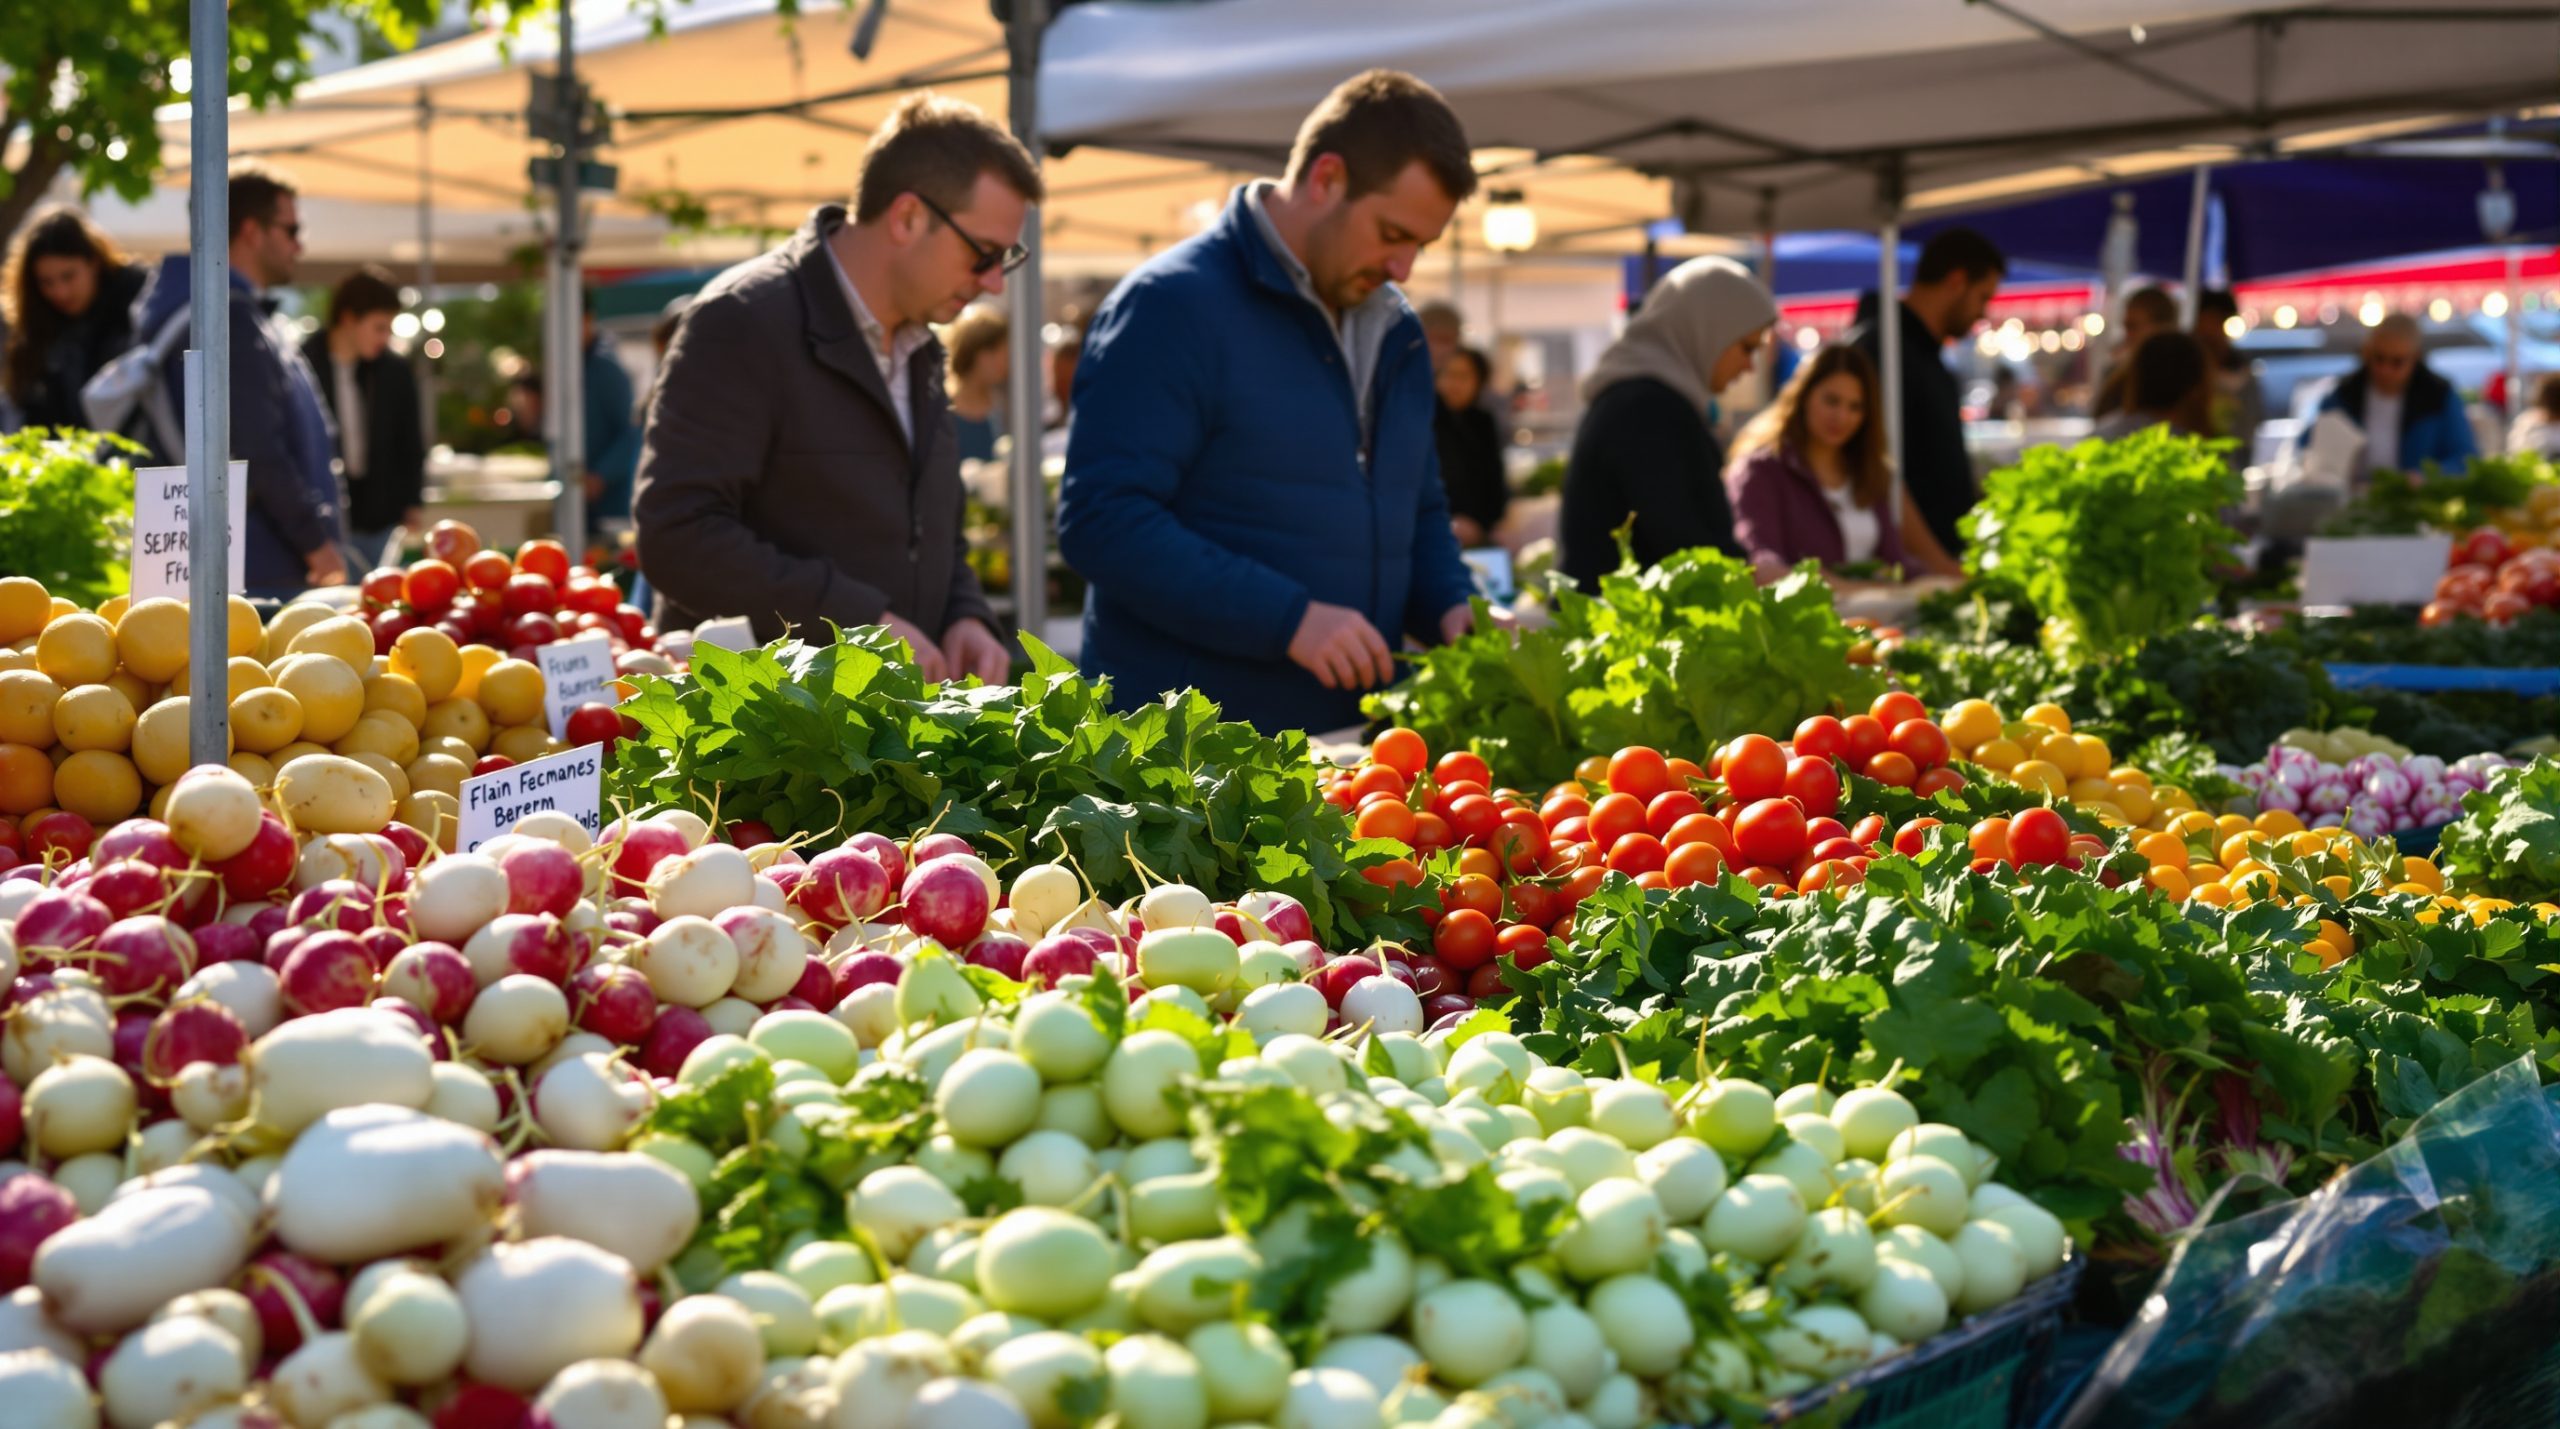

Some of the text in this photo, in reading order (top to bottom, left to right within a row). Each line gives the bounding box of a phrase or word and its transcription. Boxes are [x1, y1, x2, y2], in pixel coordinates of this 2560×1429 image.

[470, 758, 595, 811] Flain Fecmanes
[494, 796, 555, 828] Bererm
